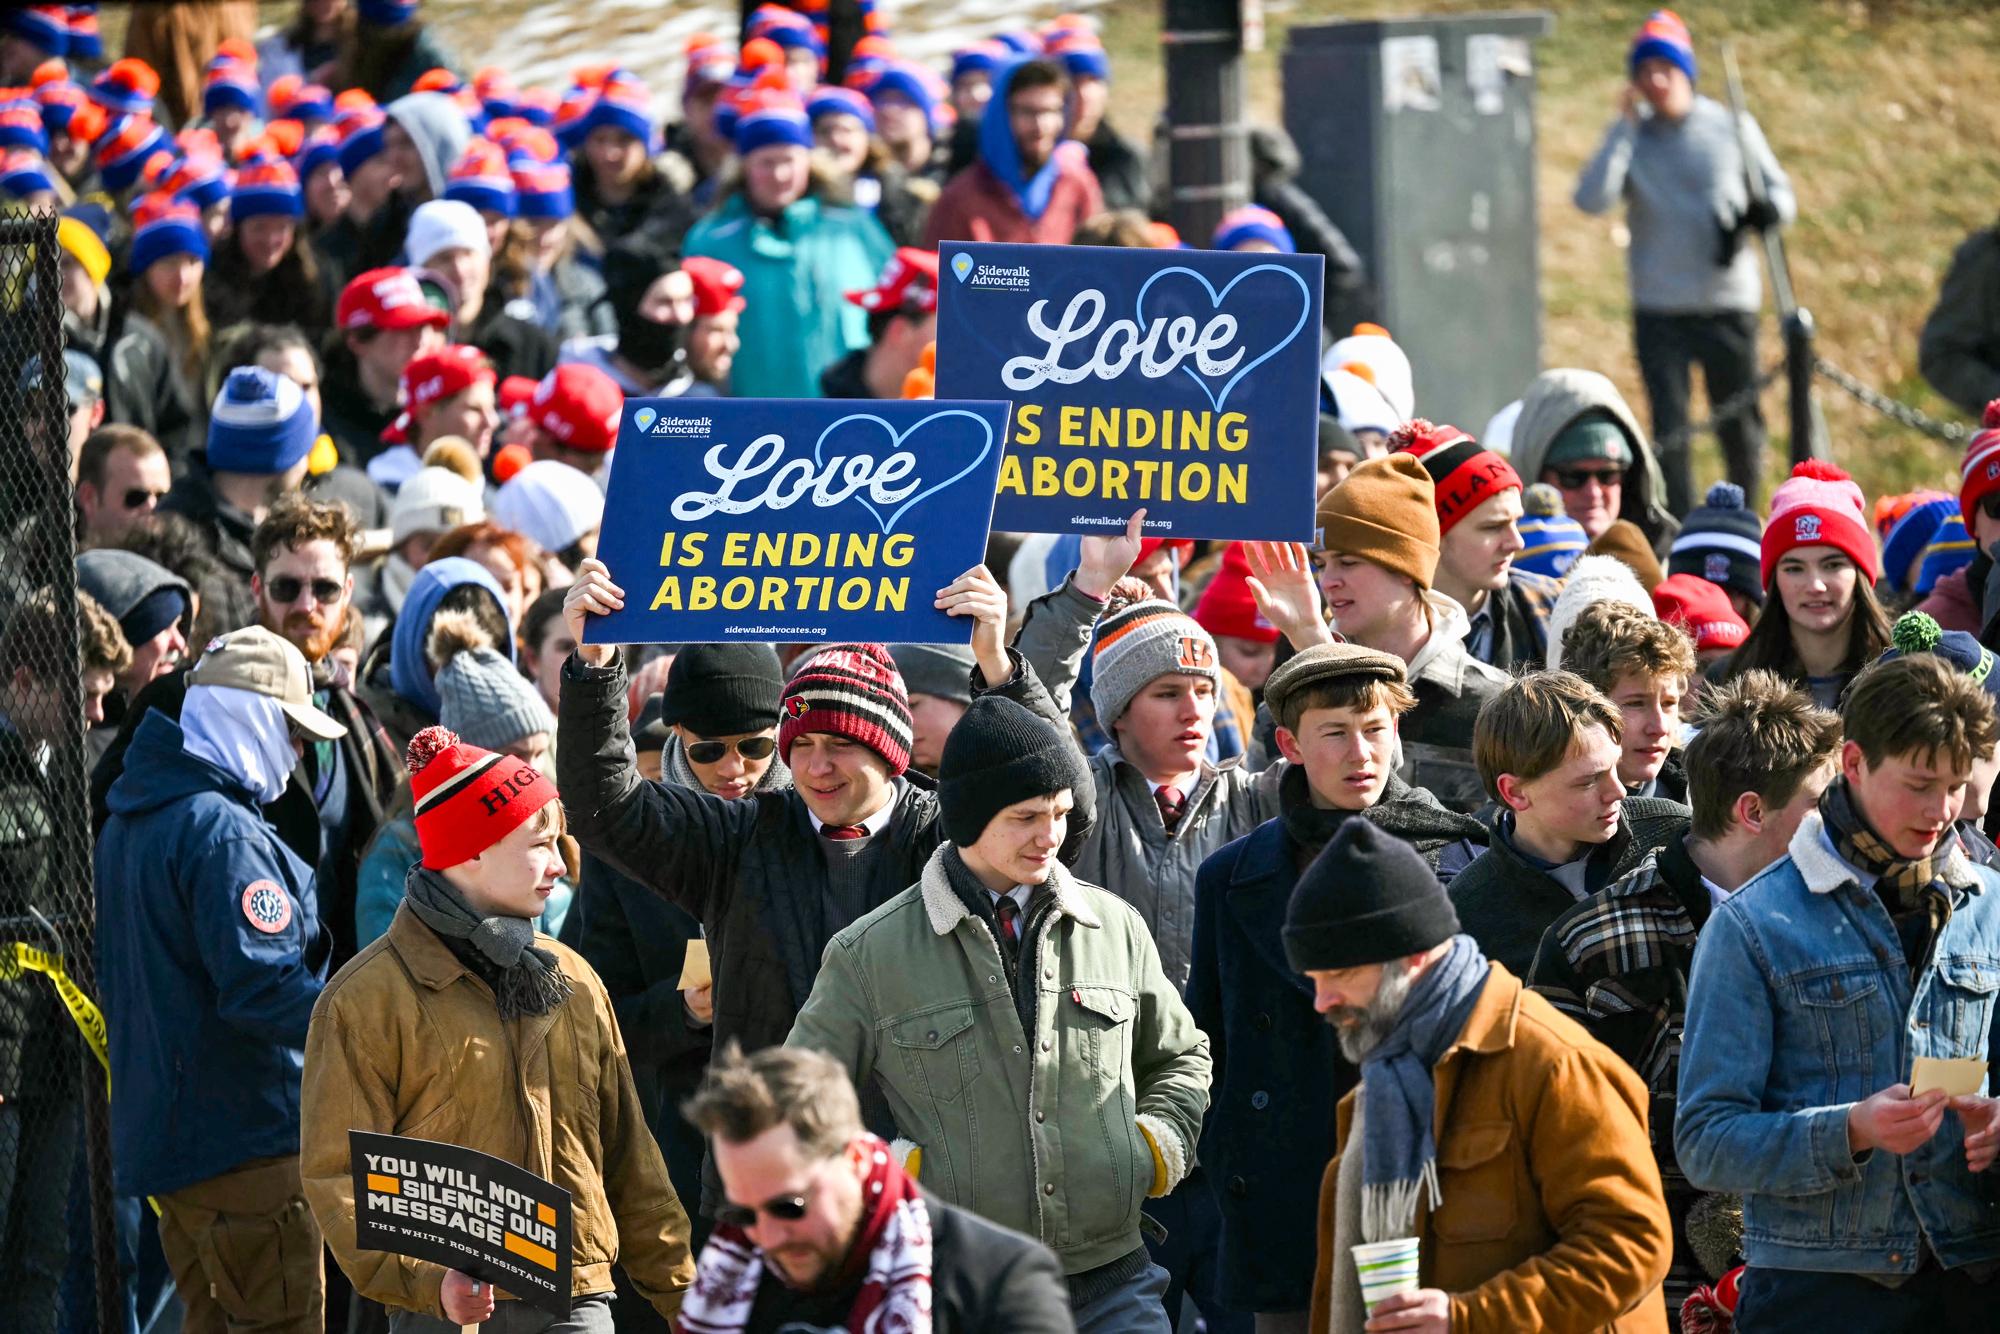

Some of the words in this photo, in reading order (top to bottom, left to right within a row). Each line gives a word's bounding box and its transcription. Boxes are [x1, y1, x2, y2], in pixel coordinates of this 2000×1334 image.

[971, 274, 1030, 286] Advocates
[978, 265, 1030, 277] Sidewalk
[1001, 289, 1246, 391] Love
[651, 425, 711, 434] Advocates
[660, 417, 712, 426] Sidewalk
[1005, 404, 1044, 445] S
[1059, 405, 1249, 452] ENDING
[670, 433, 922, 522] Love
[996, 454, 1249, 503] ABORTION
[1071, 515, 1173, 530] sidewalkadvtes.org
[659, 532, 709, 567] IS
[721, 532, 915, 568] ENDING
[649, 576, 911, 612] ABORTION
[724, 626, 827, 635] sidewalkadvocates.org
[364, 1153, 418, 1177] YOU
[423, 1163, 483, 1195] WILL
[489, 1180, 536, 1216] NOT
[367, 1192, 502, 1247] MESSAGE
[403, 1179, 504, 1226] SILENCE
[510, 1211, 557, 1250] OUR
[368, 1221, 397, 1233] THE
[401, 1227, 445, 1245] WHITE
[450, 1240, 480, 1257] ROSE
[484, 1254, 557, 1293] RESISTANCE
